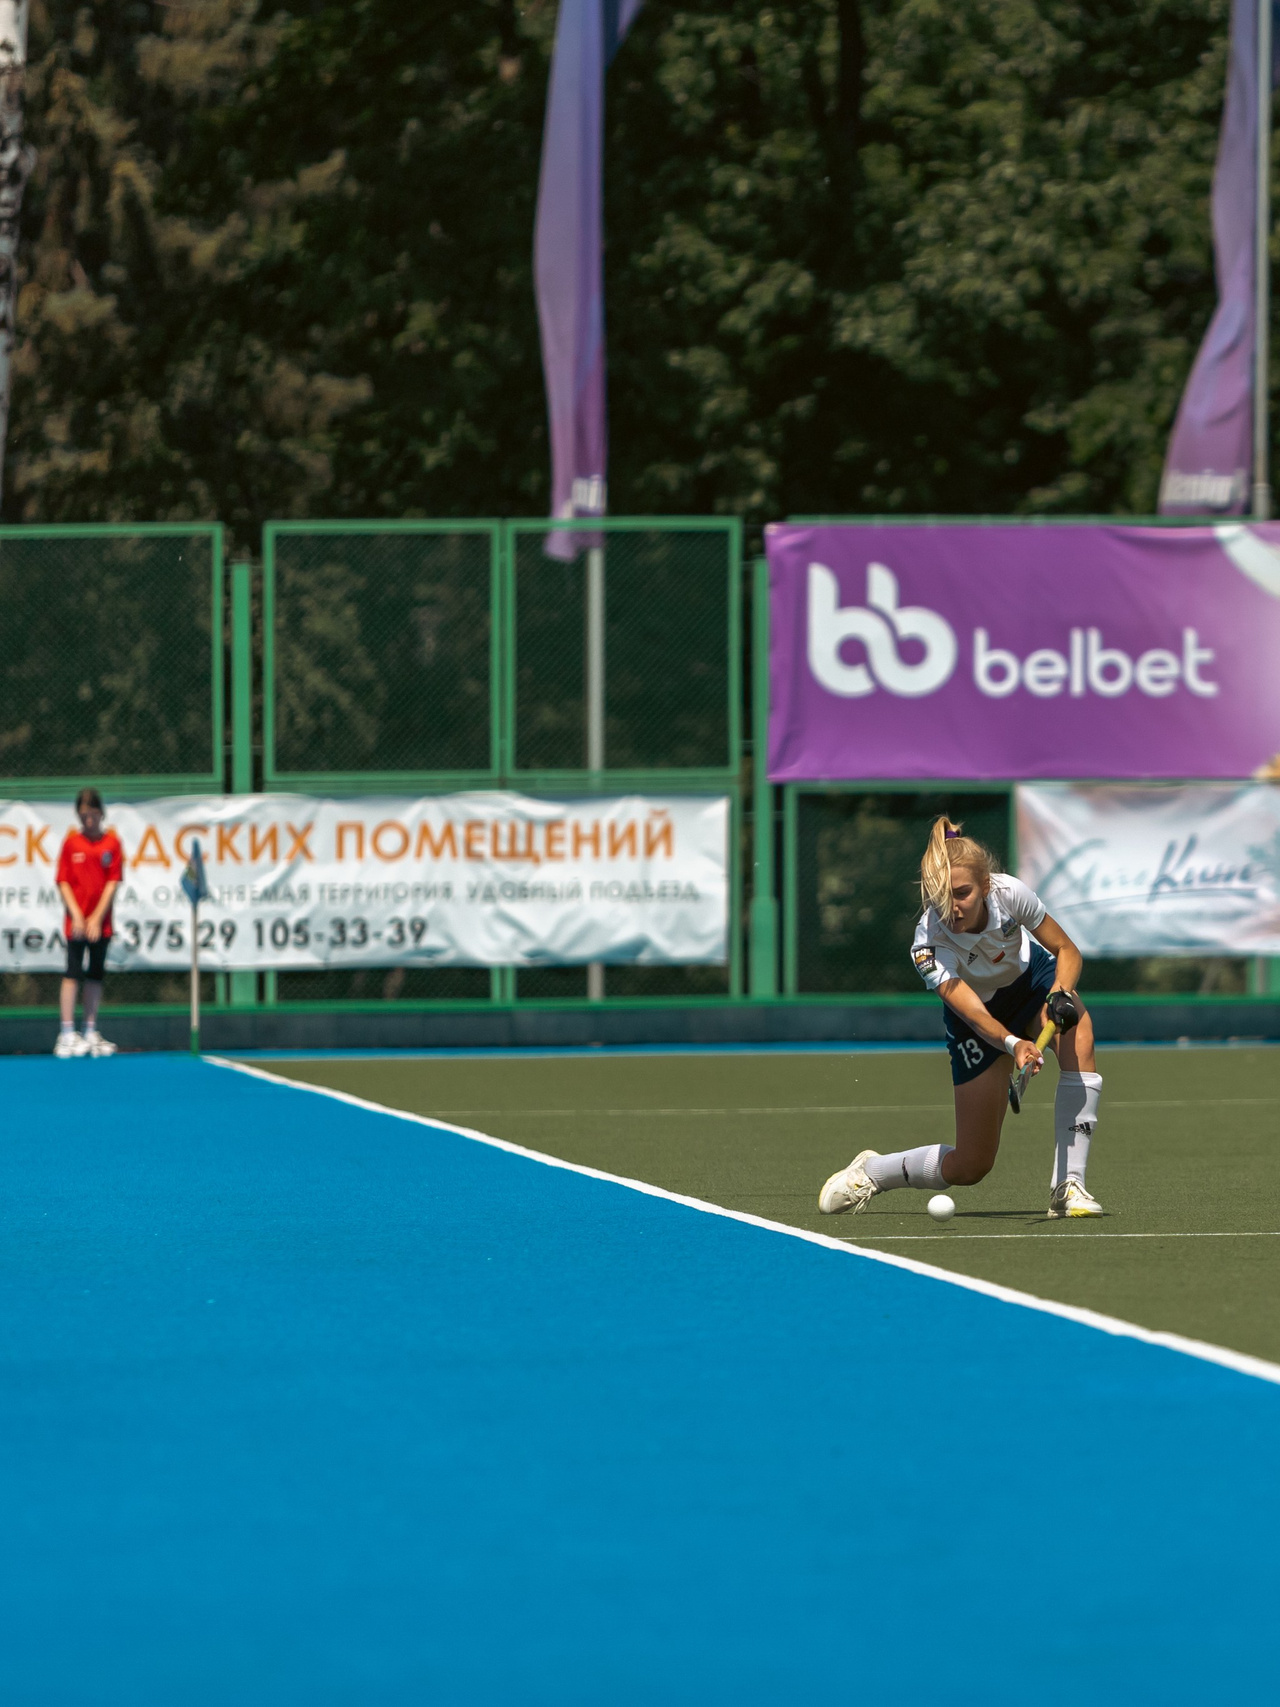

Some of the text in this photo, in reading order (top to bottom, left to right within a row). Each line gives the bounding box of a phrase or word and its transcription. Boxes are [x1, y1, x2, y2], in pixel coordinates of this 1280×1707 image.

[973, 627, 1218, 698] belbet
[0, 810, 676, 870] СКДСКИХ ПОМЕЩЕНИЙ
[112, 918, 184, 952] 375
[197, 918, 238, 950] 29
[252, 915, 429, 950] 105-33-39
[957, 1038, 985, 1069] 13
